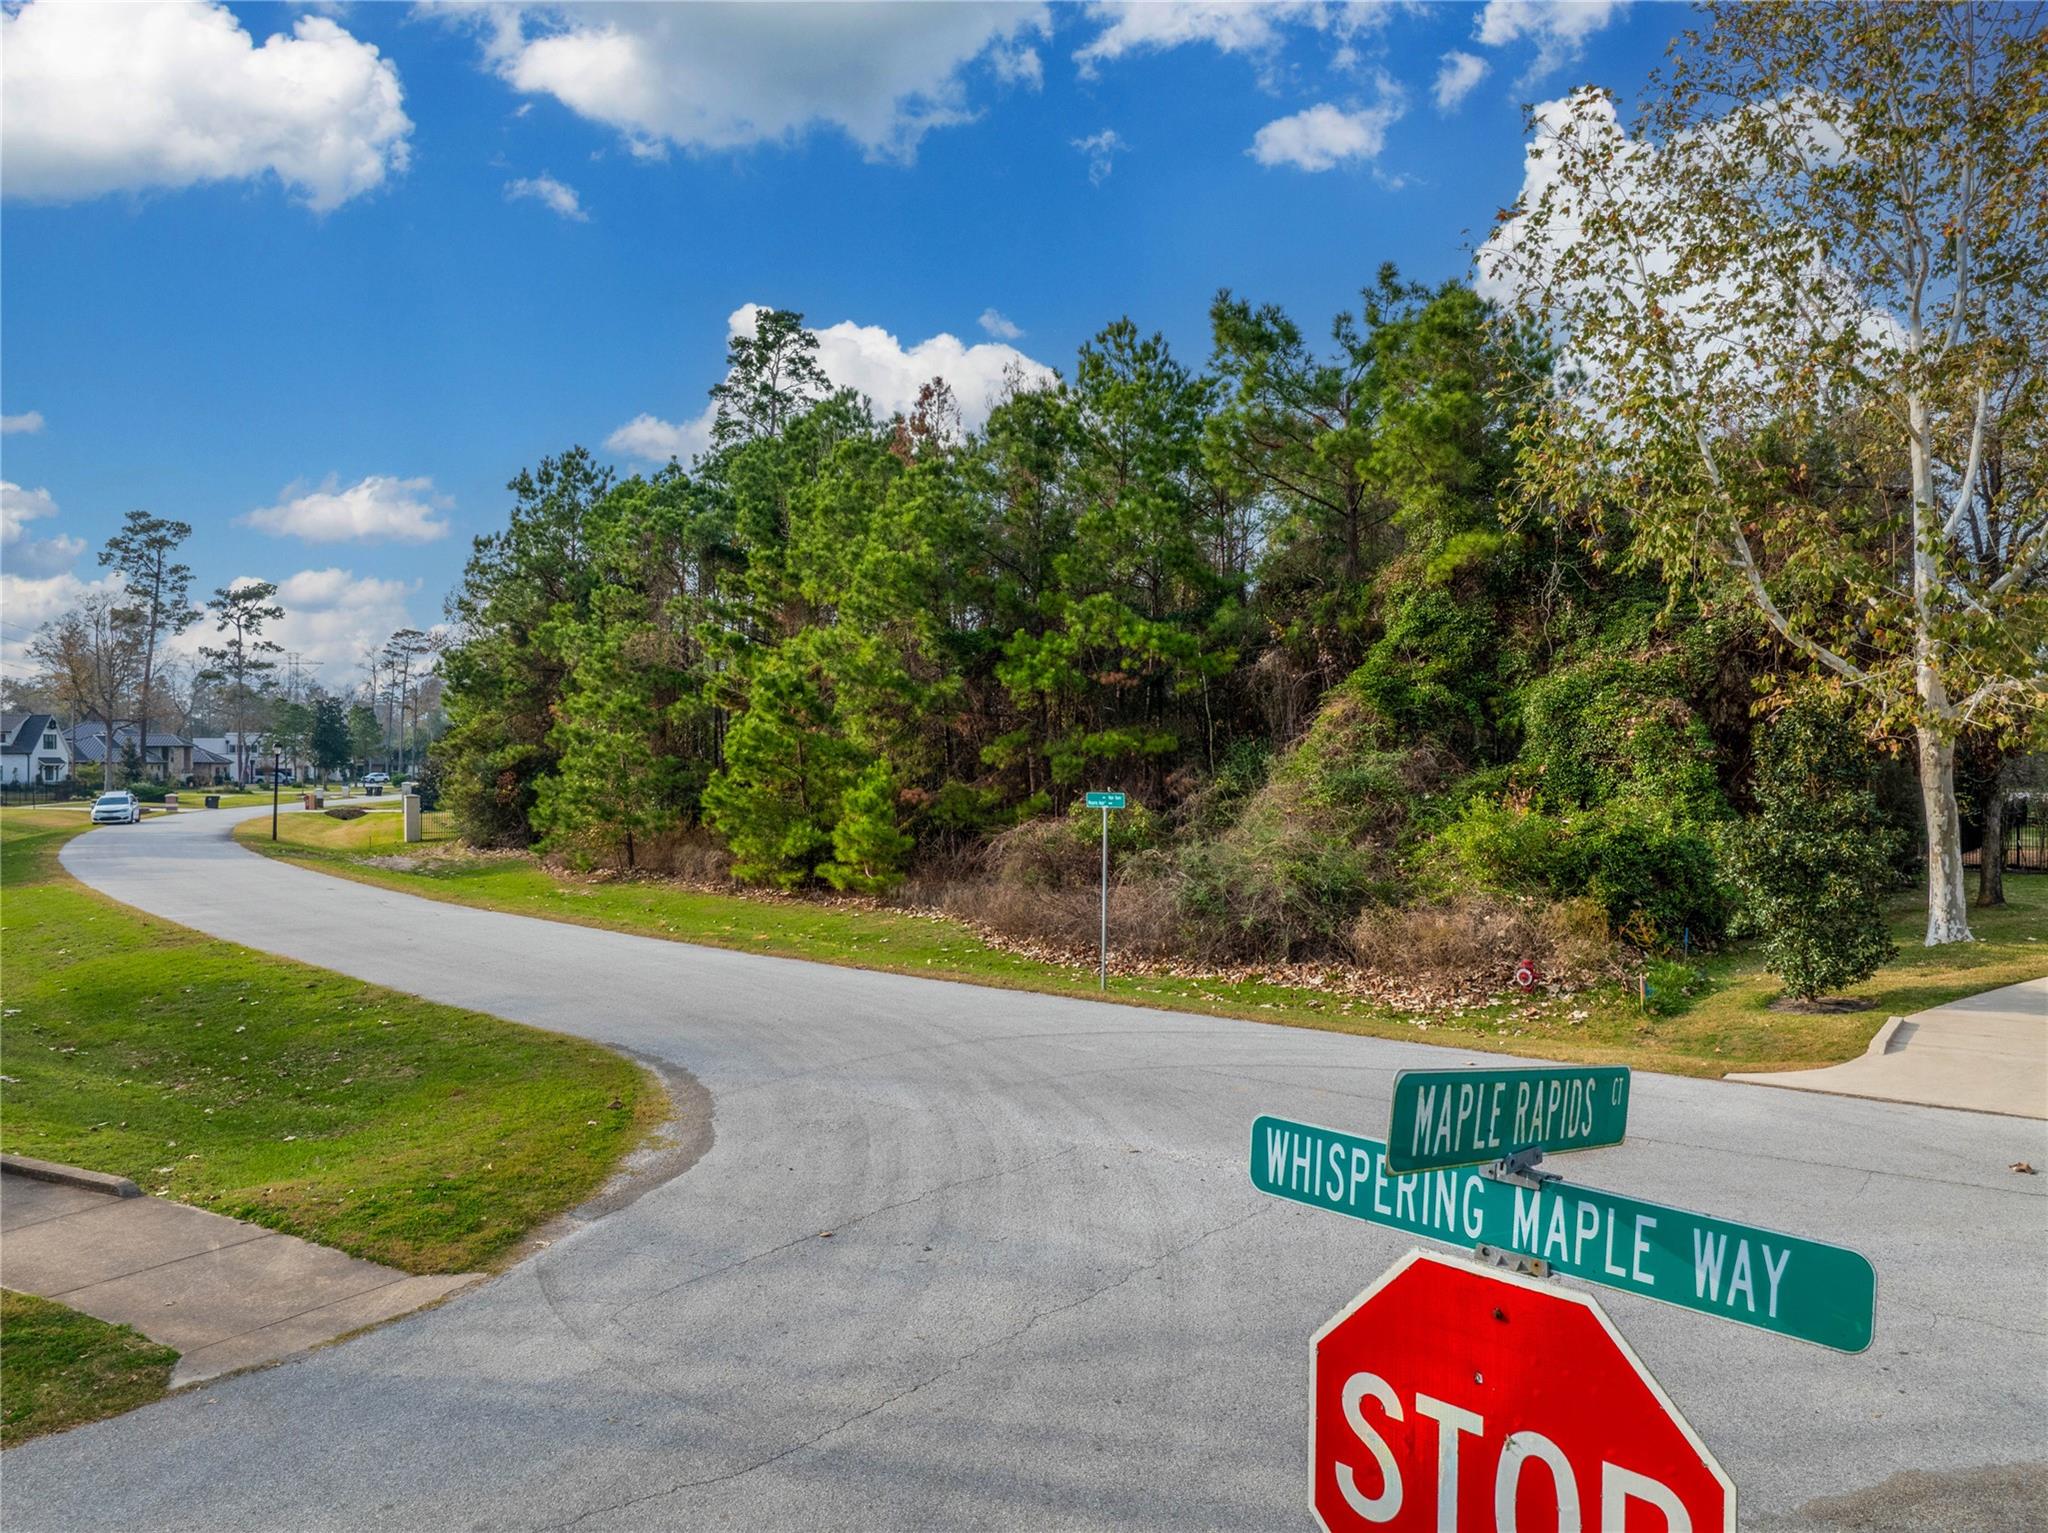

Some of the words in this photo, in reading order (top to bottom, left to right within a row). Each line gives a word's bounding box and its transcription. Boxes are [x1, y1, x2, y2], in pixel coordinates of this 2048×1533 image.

[1411, 1082, 1506, 1156] MAPLE
[1513, 1077, 1596, 1144] RAPIDS
[1611, 1077, 1625, 1106] CT
[1266, 1126, 1486, 1240] WHISPERING
[1512, 1185, 1657, 1285] MAPLE
[1693, 1227, 1791, 1318] WAY
